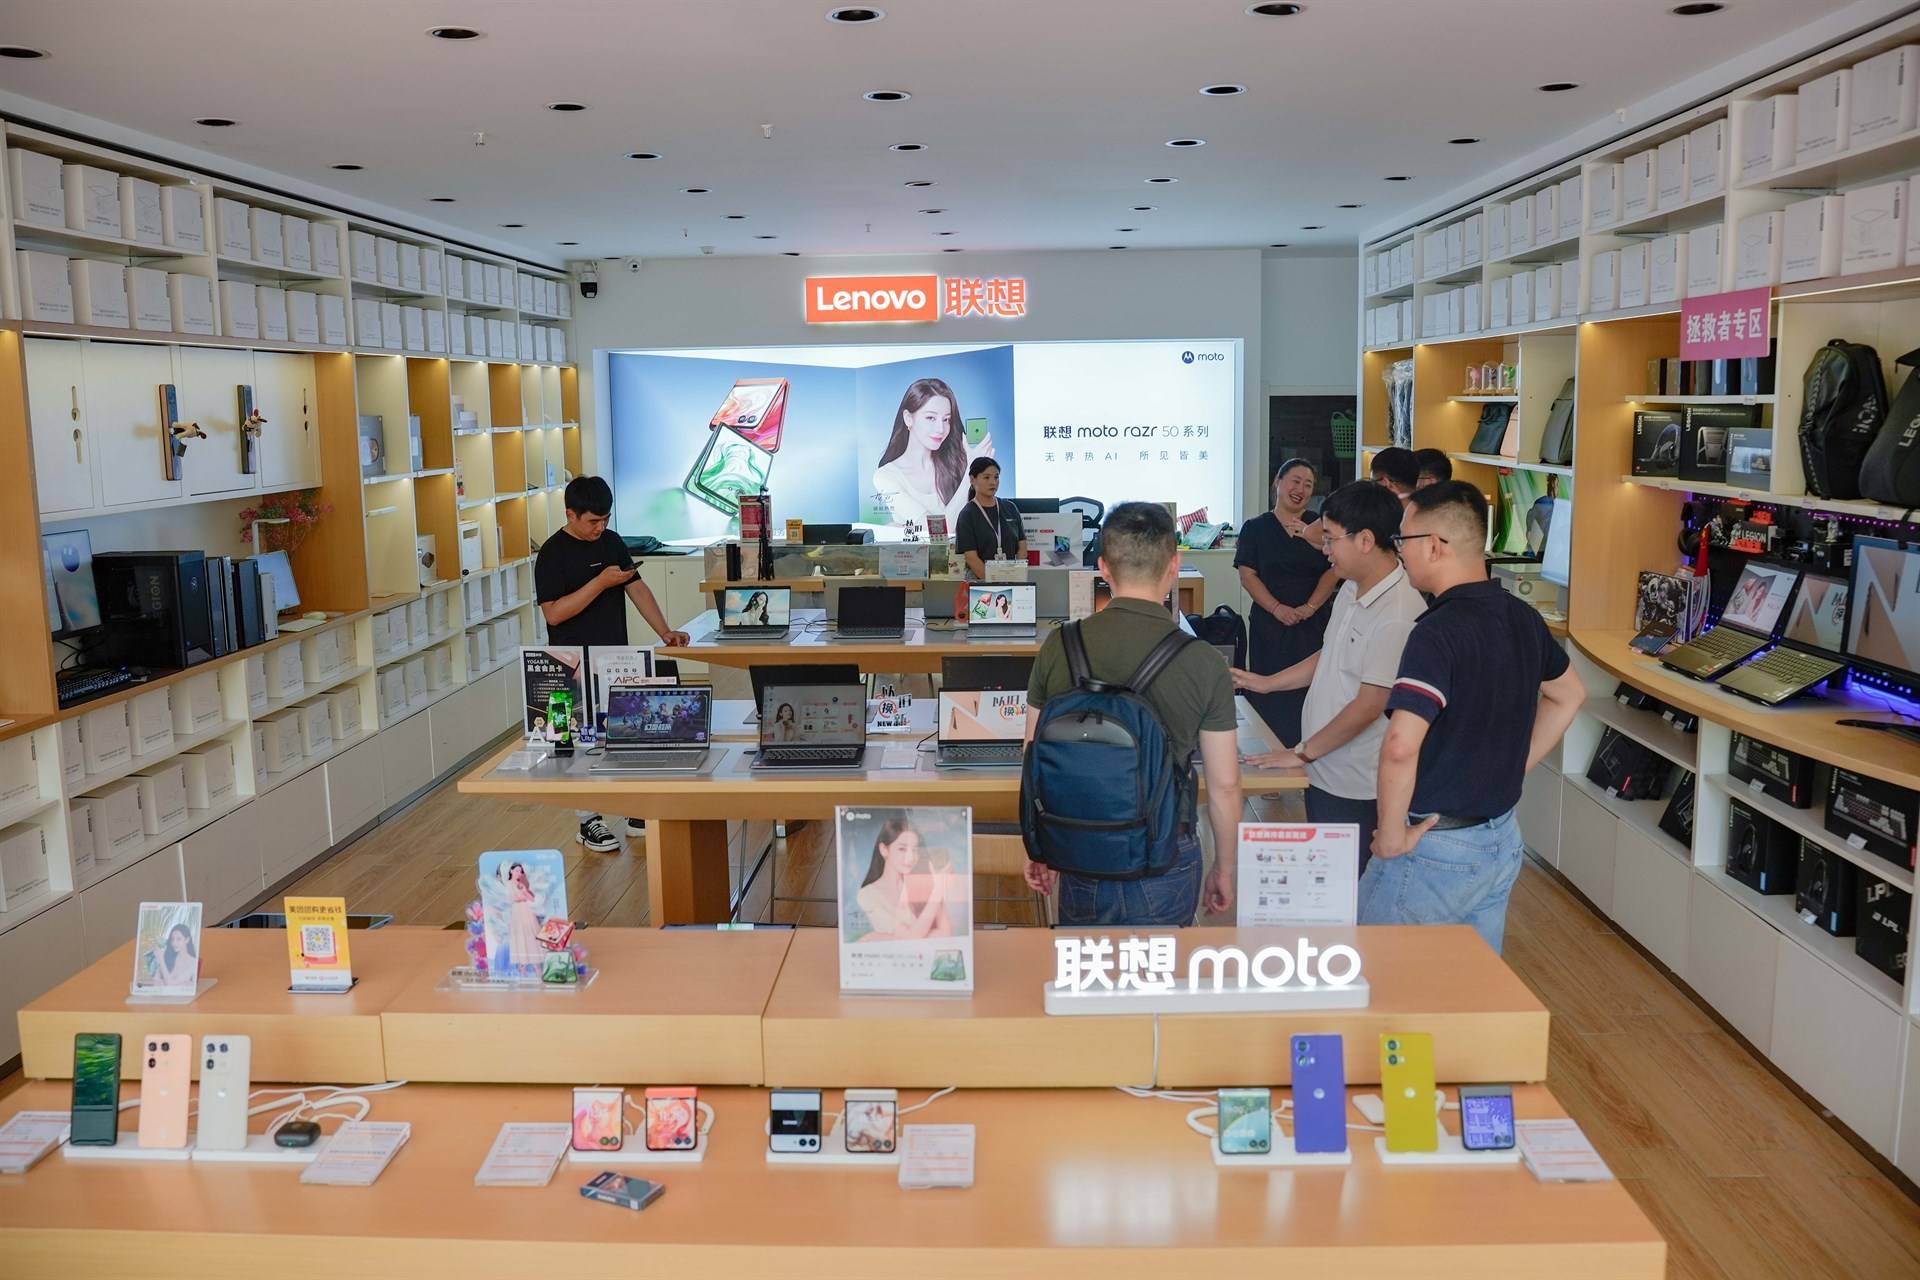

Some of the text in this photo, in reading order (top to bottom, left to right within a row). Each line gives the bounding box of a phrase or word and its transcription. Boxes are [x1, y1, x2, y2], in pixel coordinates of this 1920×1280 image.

[816, 277, 1025, 317] Lenovo 联想
[1686, 308, 1763, 344] 拯救者专区
[1197, 352, 1225, 361] moto
[1043, 424, 1209, 439] 联想 moto razr 50 系列
[1044, 450, 1209, 462] 无界热AI 所见皆美
[1741, 530, 1768, 544] LEGION
[527, 664, 563, 673] 黑金会员卡
[1054, 936, 1362, 994] 联想 moto
